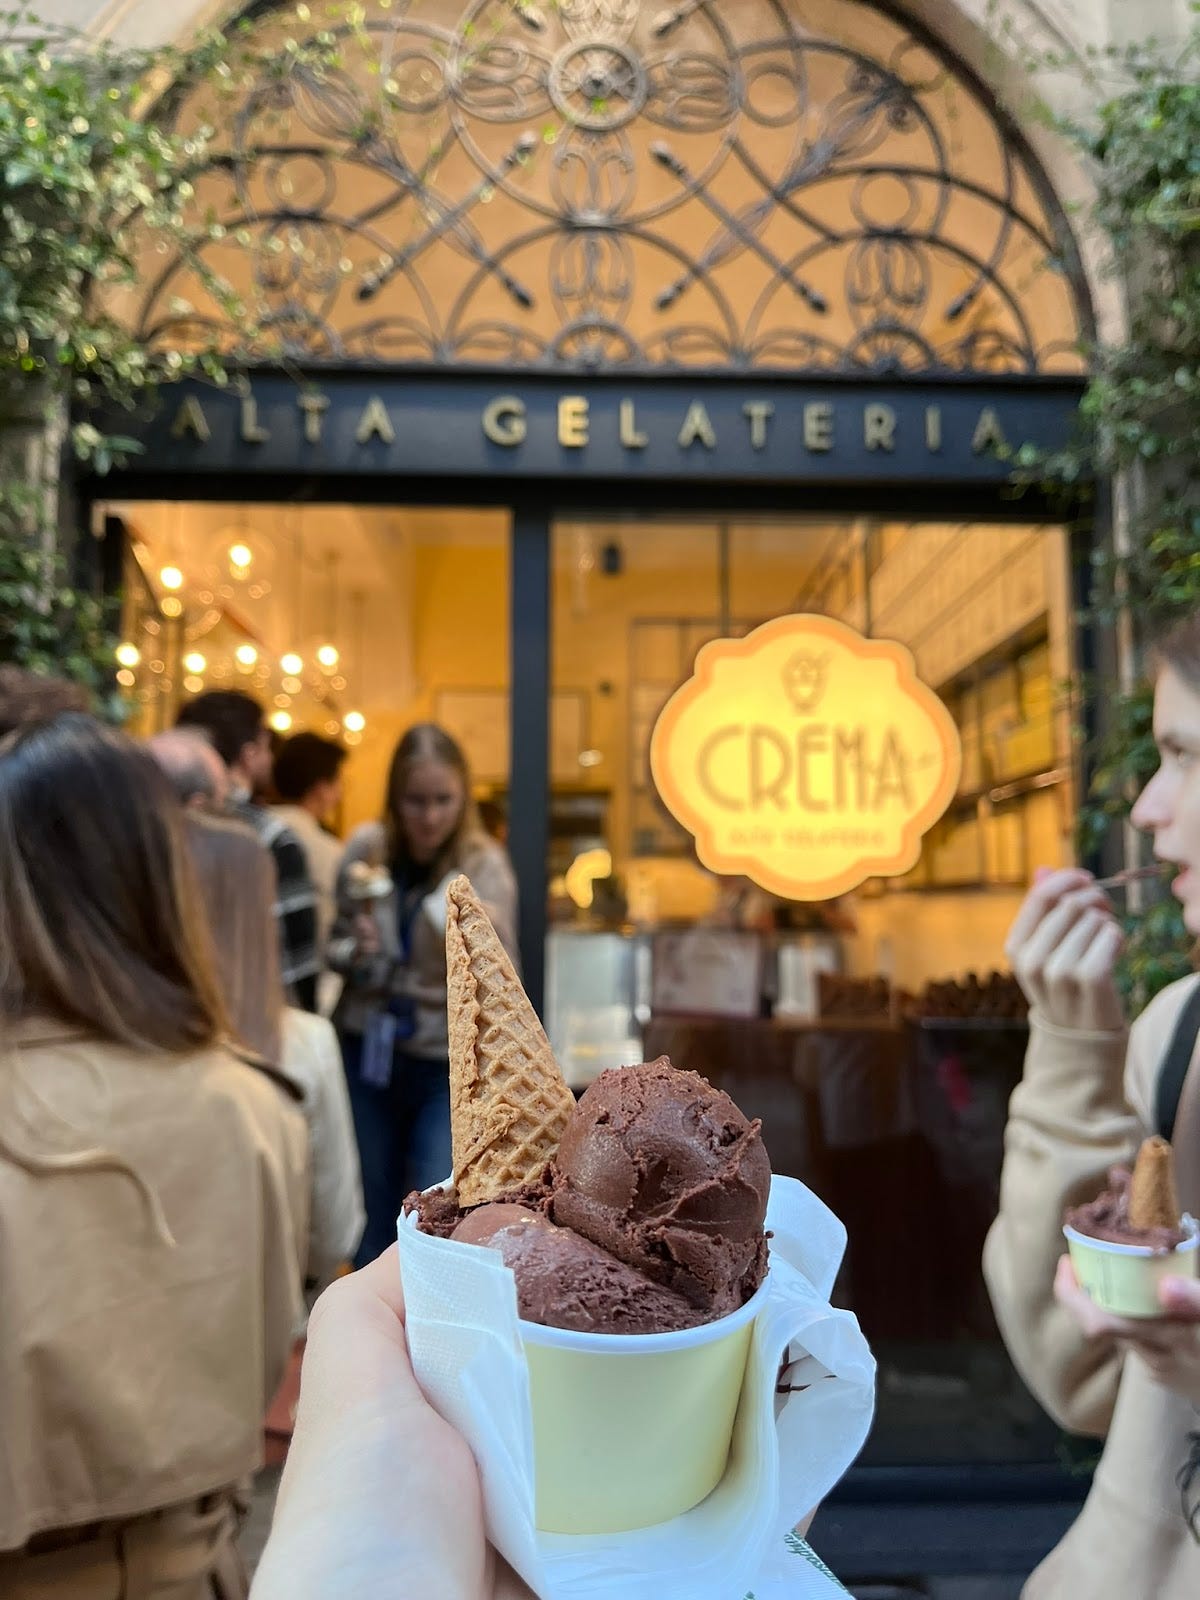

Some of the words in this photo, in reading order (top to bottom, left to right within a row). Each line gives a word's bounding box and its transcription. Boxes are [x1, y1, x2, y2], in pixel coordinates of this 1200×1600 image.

[170, 394, 398, 445] ALTA
[481, 395, 1008, 452] GELATERIA
[696, 722, 913, 815] CREMA
